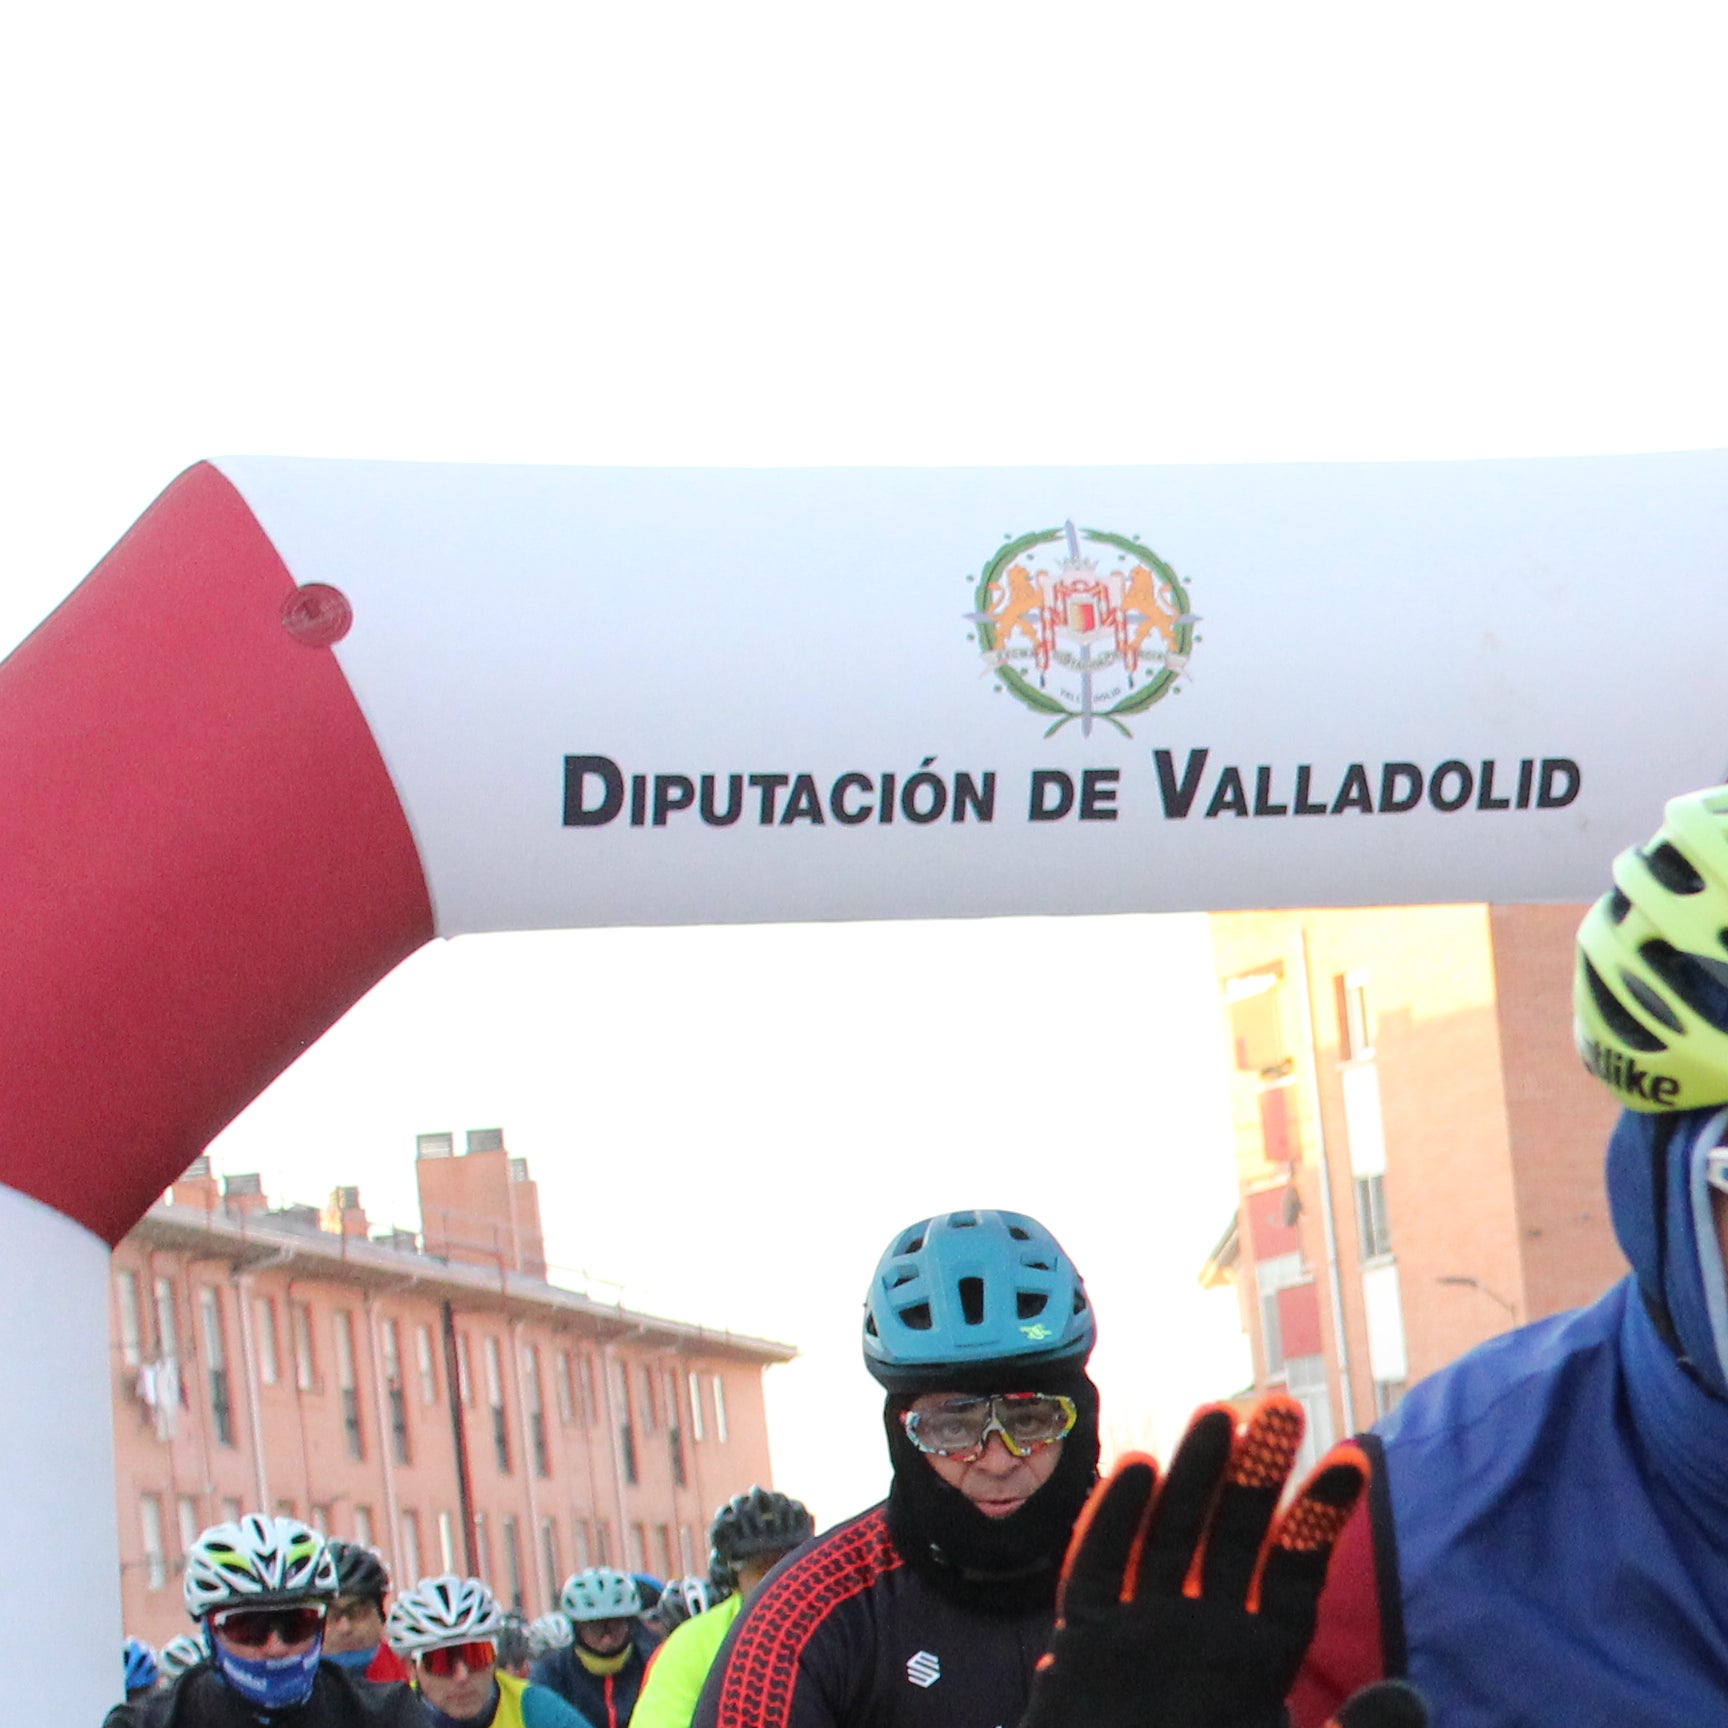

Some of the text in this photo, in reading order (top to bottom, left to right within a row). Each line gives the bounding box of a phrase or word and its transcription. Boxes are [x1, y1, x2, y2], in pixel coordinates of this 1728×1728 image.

[560, 746, 1582, 827] DIPUTACIÓN DE VALLADOLID
